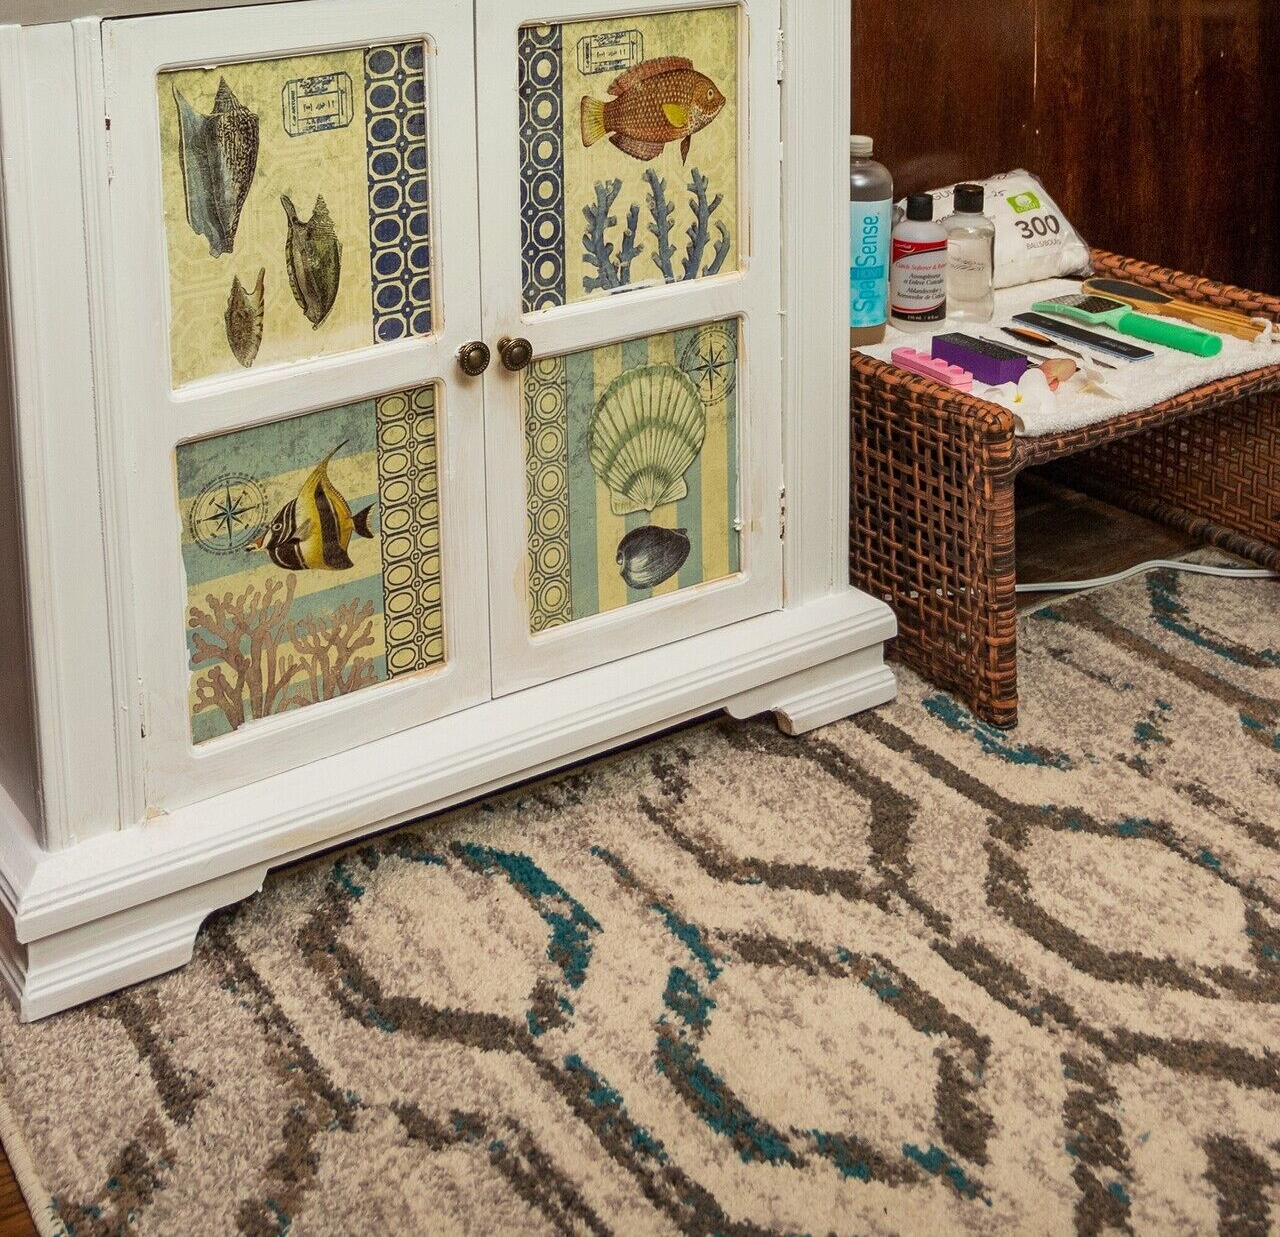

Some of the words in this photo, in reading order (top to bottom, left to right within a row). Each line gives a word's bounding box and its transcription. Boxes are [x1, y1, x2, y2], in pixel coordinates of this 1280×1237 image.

[855, 216, 879, 266] Sense
[1014, 214, 1060, 239] 300
[852, 280, 881, 312] Spa
